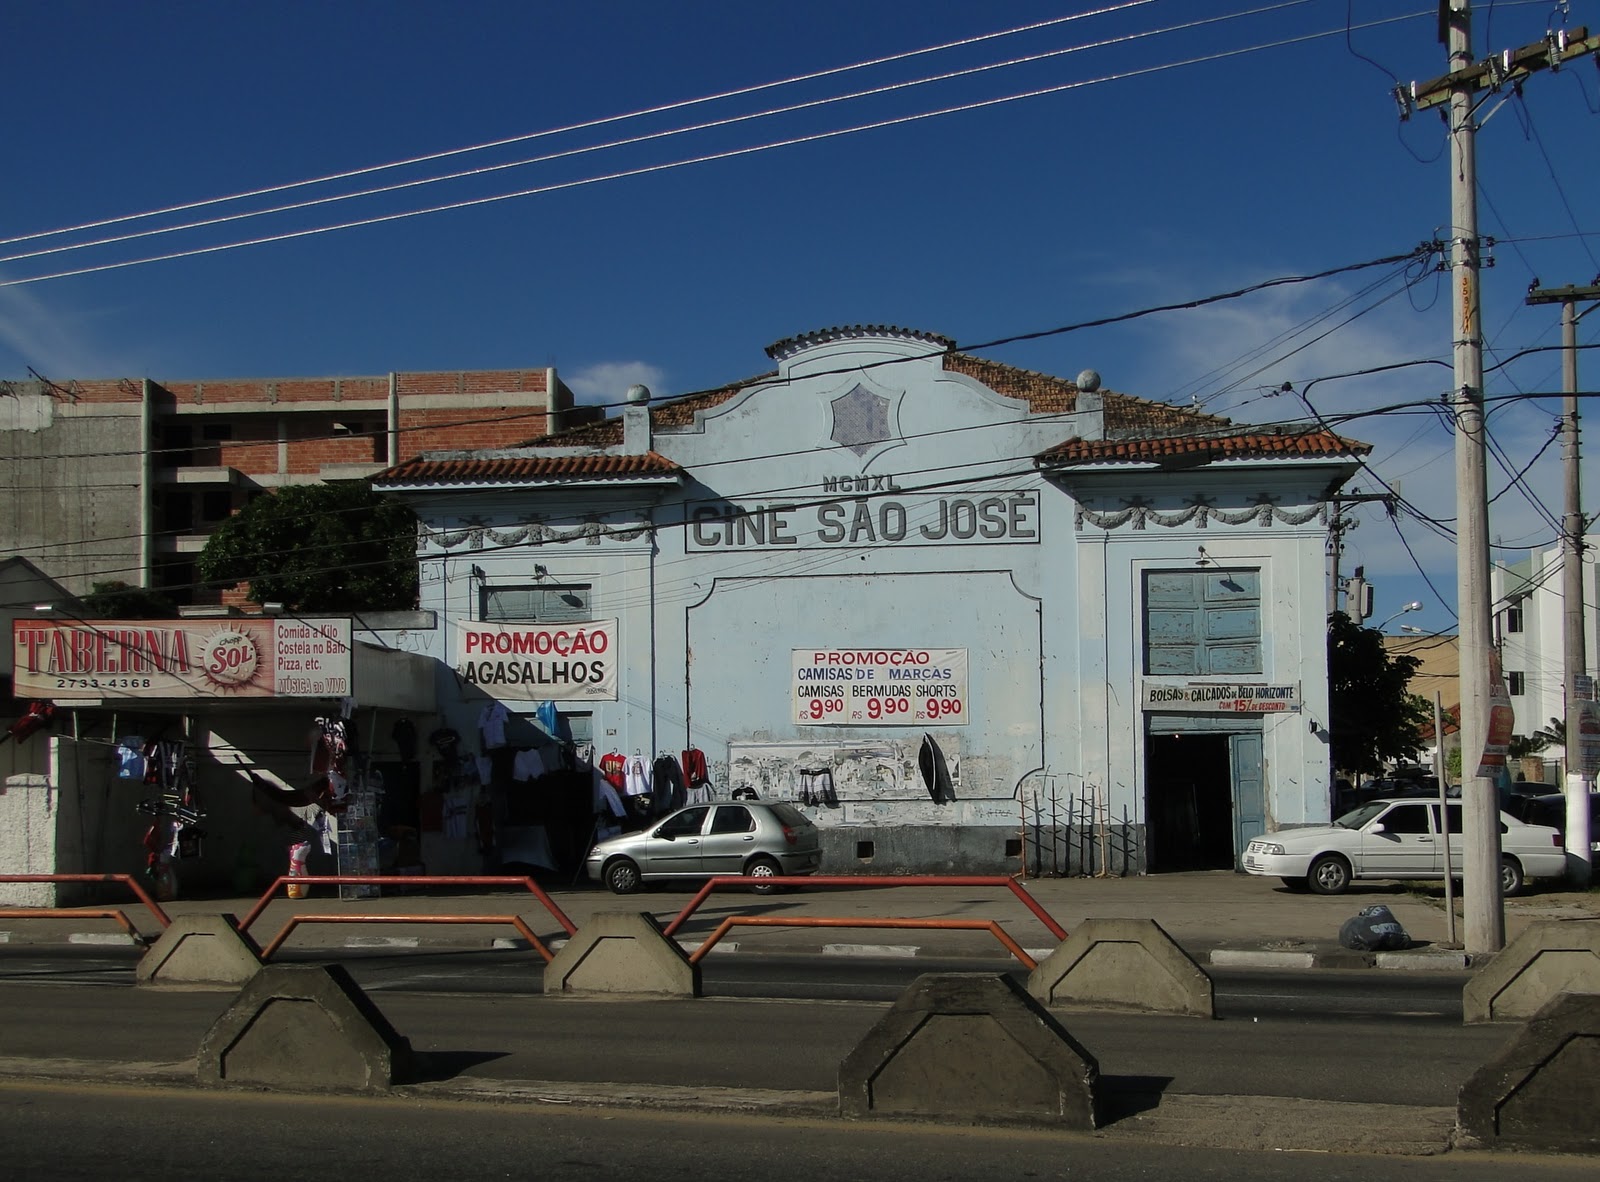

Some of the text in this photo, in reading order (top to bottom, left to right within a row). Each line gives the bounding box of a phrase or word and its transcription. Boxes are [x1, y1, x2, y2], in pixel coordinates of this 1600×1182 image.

[823, 474, 901, 493] MCMXL
[692, 492, 1036, 546] CINE SÃO JOSÉ
[278, 624, 338, 639] Comida a Kilo
[278, 640, 311, 654] Costela
[313, 643, 324, 654] no
[466, 628, 608, 657] PROMOÇÃO
[19, 628, 191, 675] TABERNA
[210, 645, 253, 674] SOL
[814, 649, 930, 666] PROMOÇÃO
[278, 656, 322, 673] Pizza, etc.
[463, 660, 605, 685] AGASALHOS
[798, 668, 853, 681] CAMISAS
[856, 669, 875, 680] DE
[57, 678, 151, 689] 2733-4368
[278, 675, 347, 694] MÚSICA ao VIVO
[797, 684, 957, 698] CAMISAS BERMUDAS SHORTS
[1149, 688, 1183, 702] BOLSAS
[1184, 691, 1190, 701] &
[1255, 686, 1294, 699] HORIZONTE
